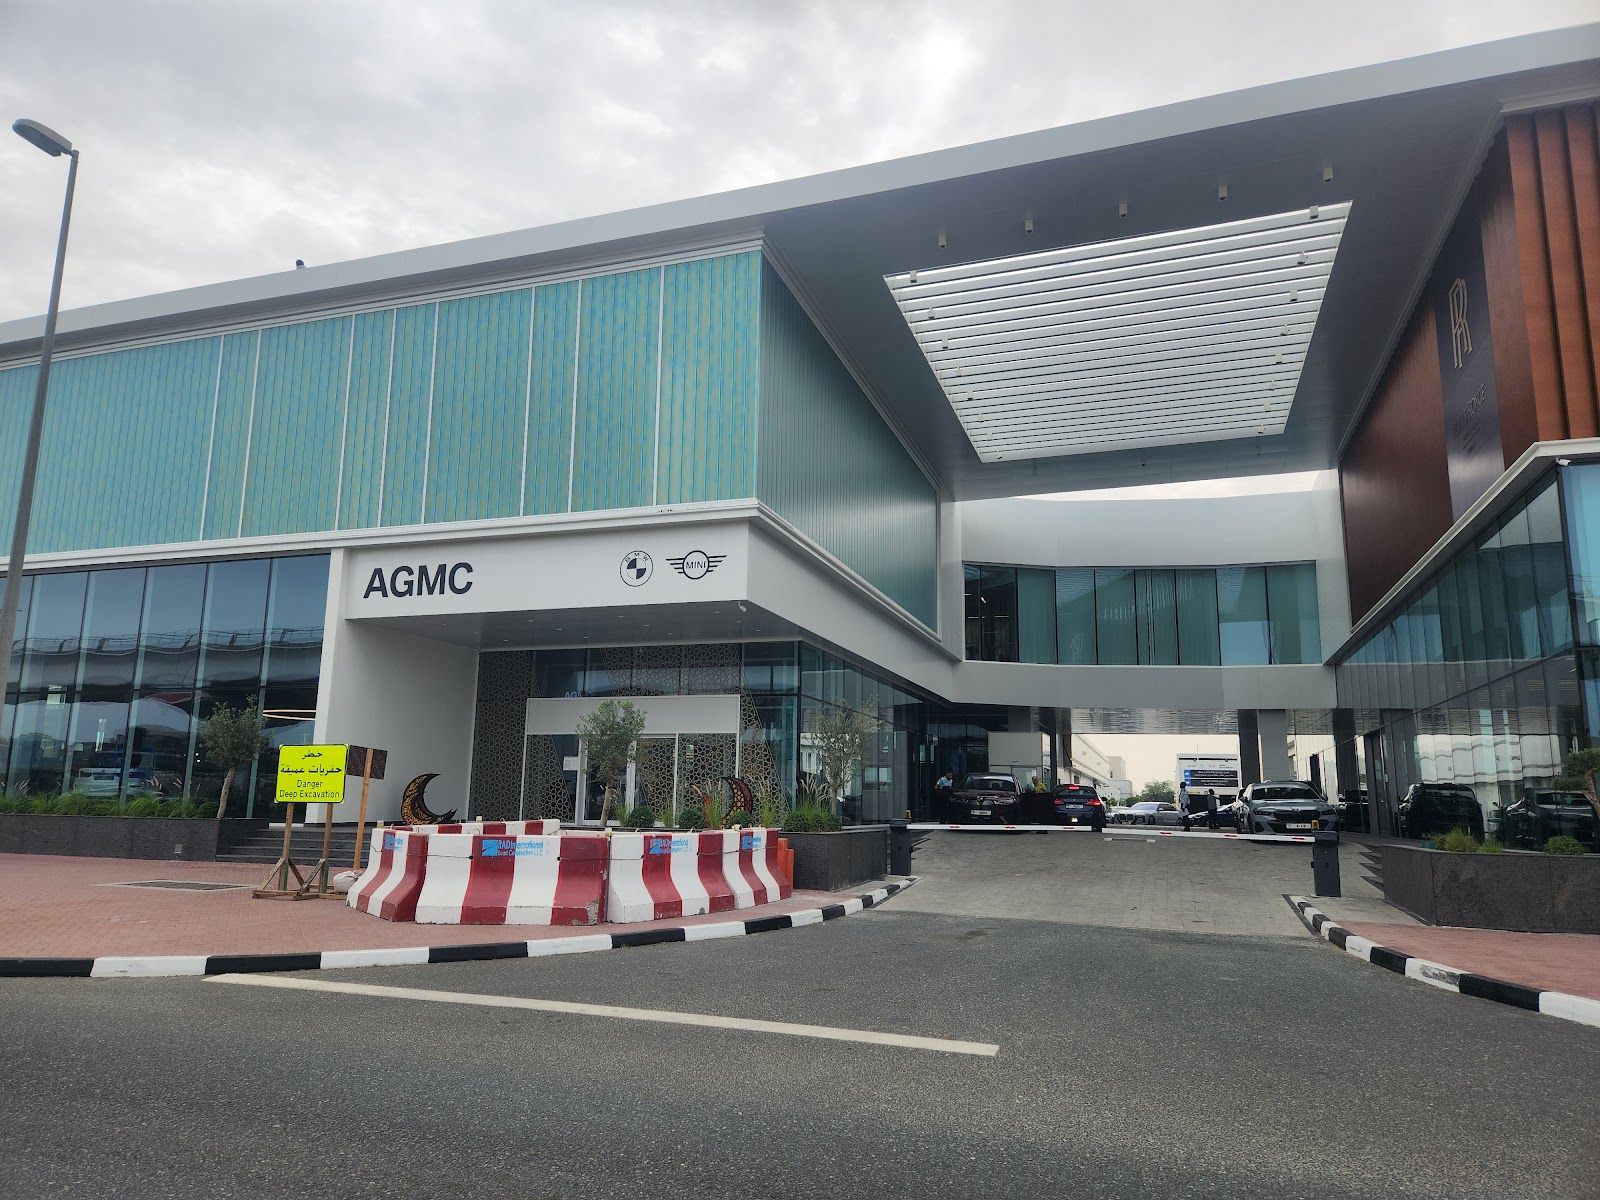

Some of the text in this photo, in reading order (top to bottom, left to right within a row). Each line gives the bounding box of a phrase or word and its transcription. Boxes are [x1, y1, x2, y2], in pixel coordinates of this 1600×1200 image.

[685, 560, 706, 569] MINI
[363, 561, 474, 599] AGMC
[296, 779, 323, 790] Danger
[279, 789, 340, 799] Deep Excavation
